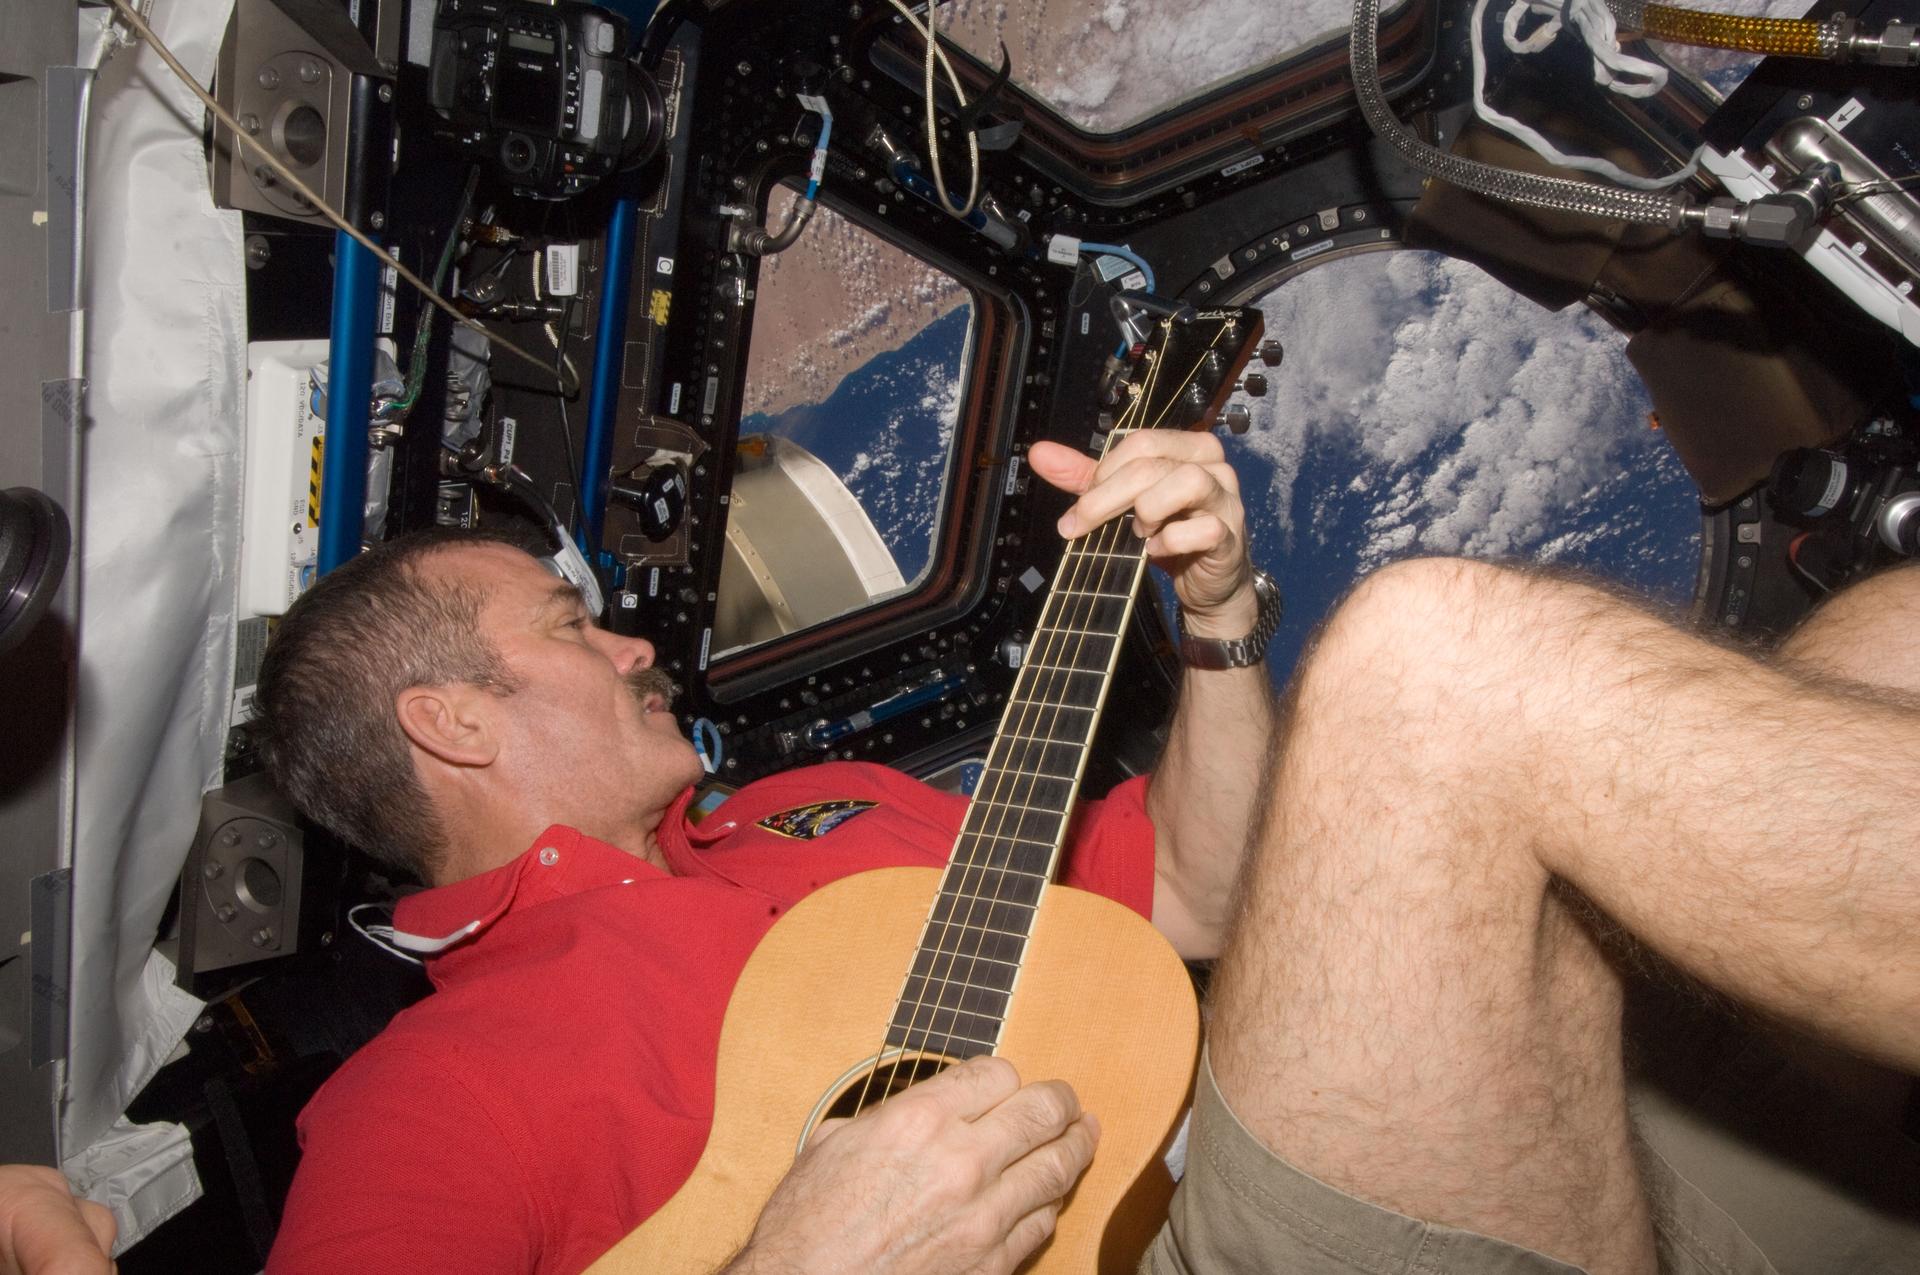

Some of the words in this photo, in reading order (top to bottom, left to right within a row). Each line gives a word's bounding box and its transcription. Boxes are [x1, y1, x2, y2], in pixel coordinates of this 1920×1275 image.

[658, 259, 672, 272] C
[505, 423, 513, 445] CUP1
[503, 449, 510, 460] P4
[623, 595, 637, 607] G
